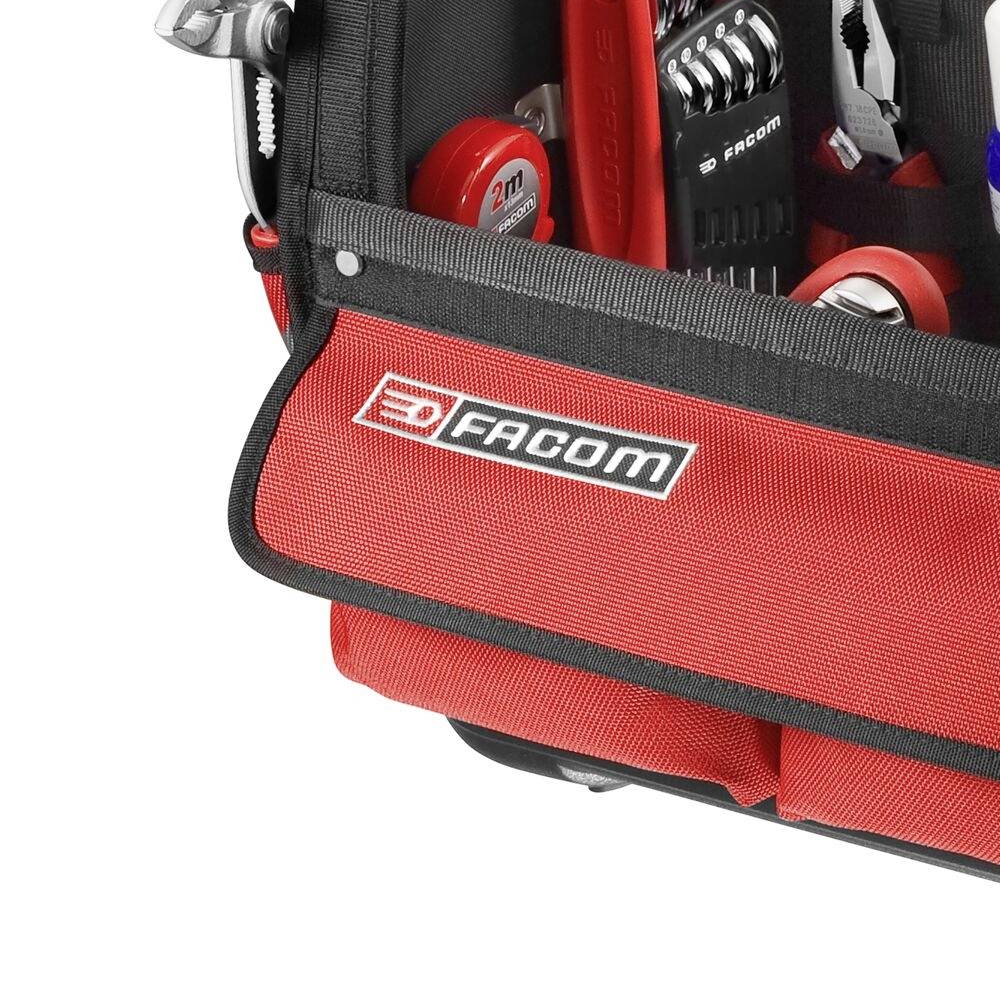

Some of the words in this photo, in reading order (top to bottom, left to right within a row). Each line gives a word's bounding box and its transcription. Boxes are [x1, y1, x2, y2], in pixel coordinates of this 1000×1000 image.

[724, 114, 781, 162] FACOM
[491, 168, 523, 215] 2m
[498, 197, 534, 234] FACOM
[450, 410, 673, 483] FACOM
